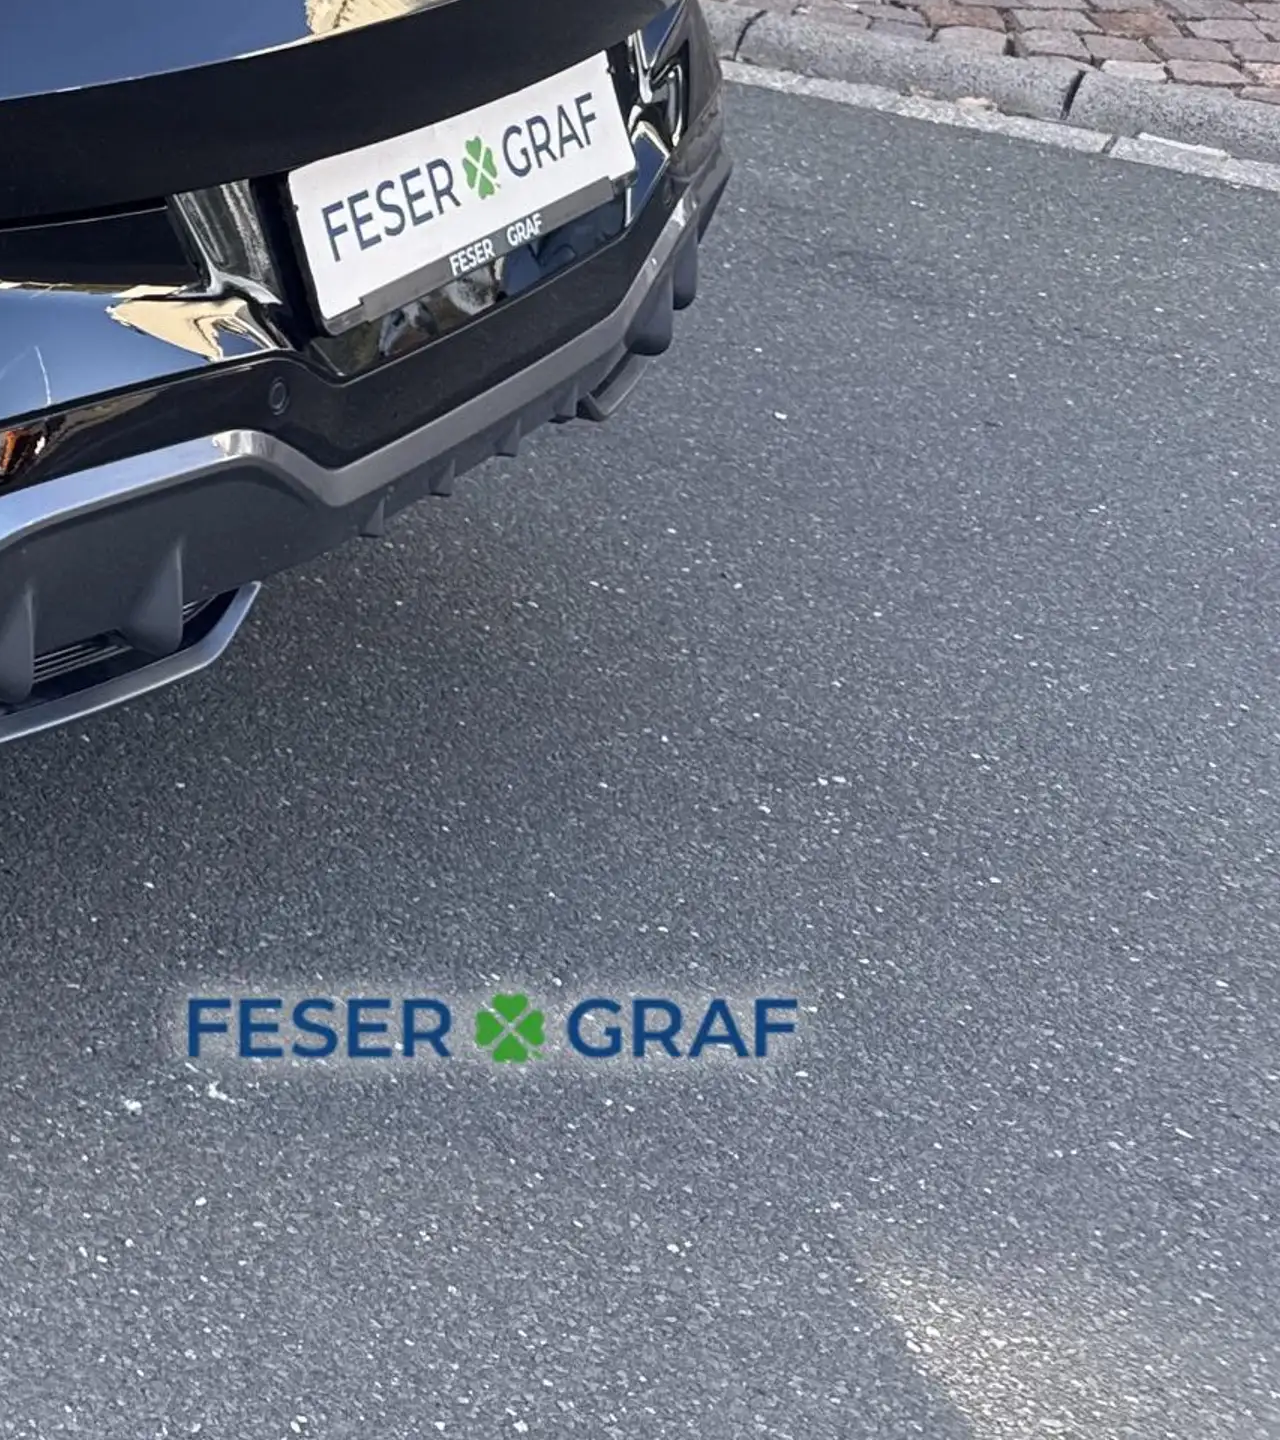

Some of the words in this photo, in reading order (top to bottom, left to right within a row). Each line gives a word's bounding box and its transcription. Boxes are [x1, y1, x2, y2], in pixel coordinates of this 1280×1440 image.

[320, 158, 462, 262] FESER
[501, 91, 598, 178] GRAF
[448, 237, 496, 277] FESER
[505, 211, 542, 247] GRAF
